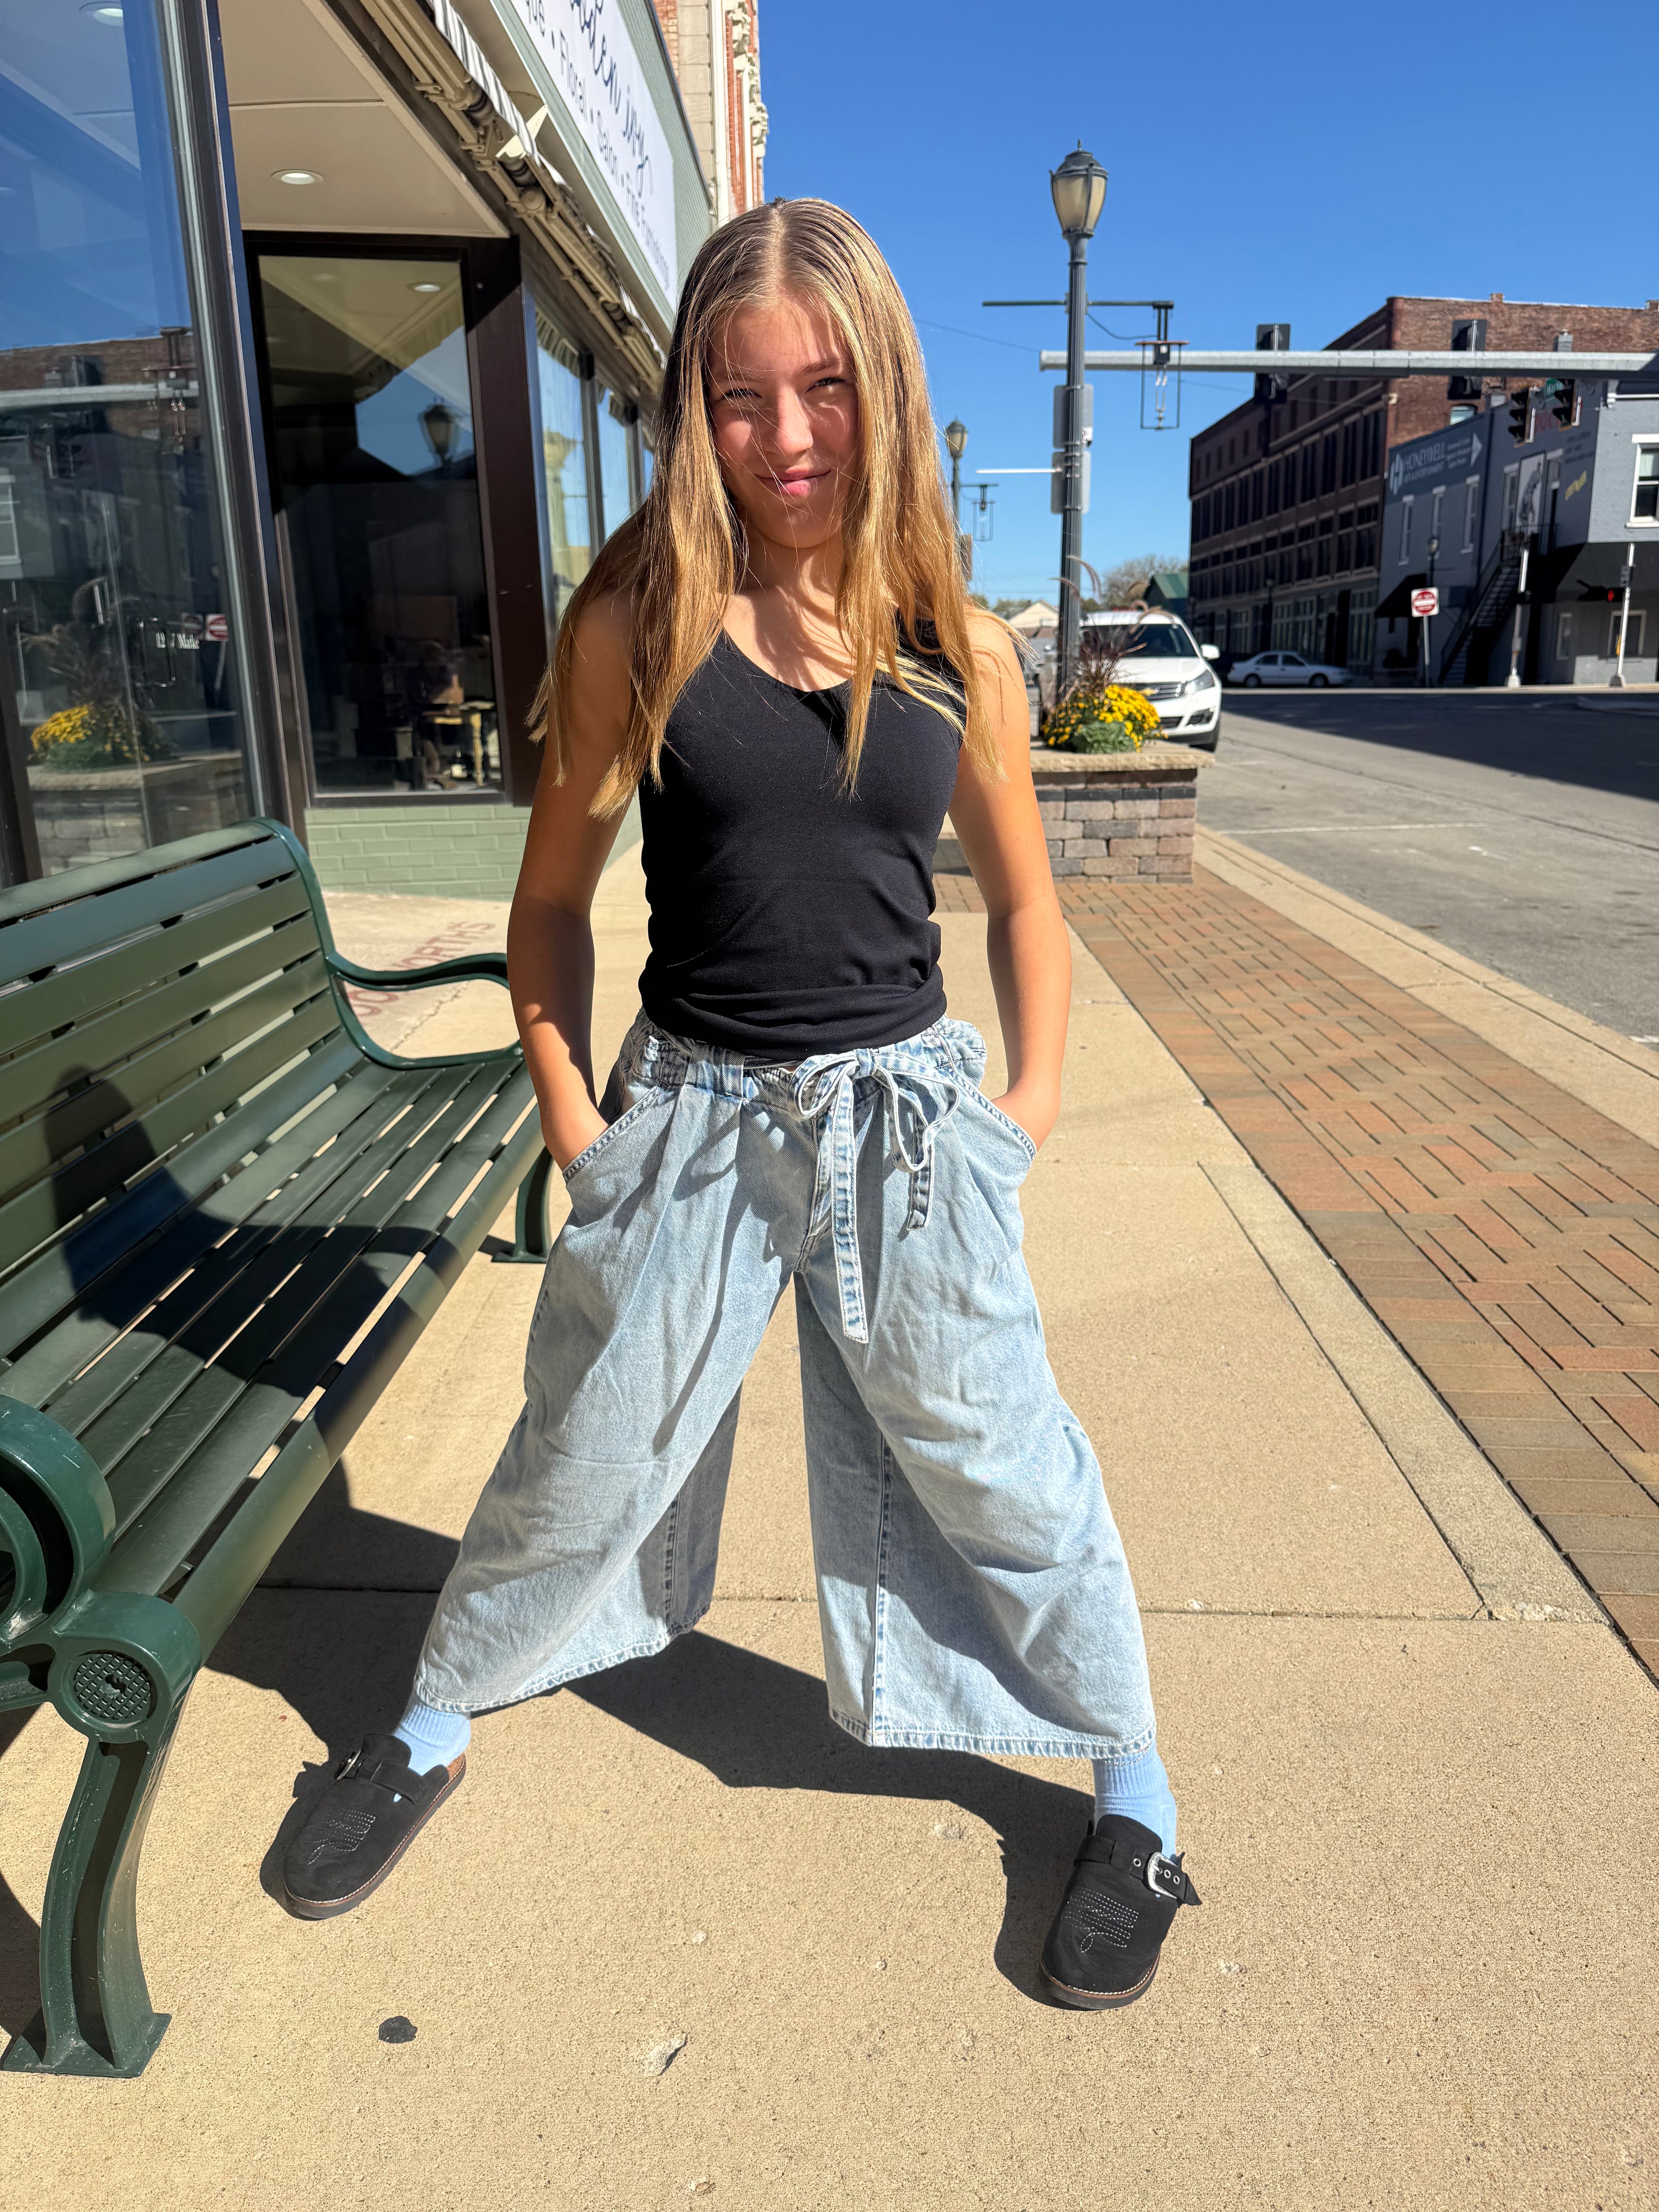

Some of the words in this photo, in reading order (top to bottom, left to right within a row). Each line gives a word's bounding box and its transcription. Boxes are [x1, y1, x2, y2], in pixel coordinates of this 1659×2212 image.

[559, 29, 588, 121] Floral
[597, 109, 619, 186] Salon
[1404, 441, 1446, 470] HONEYWELL
